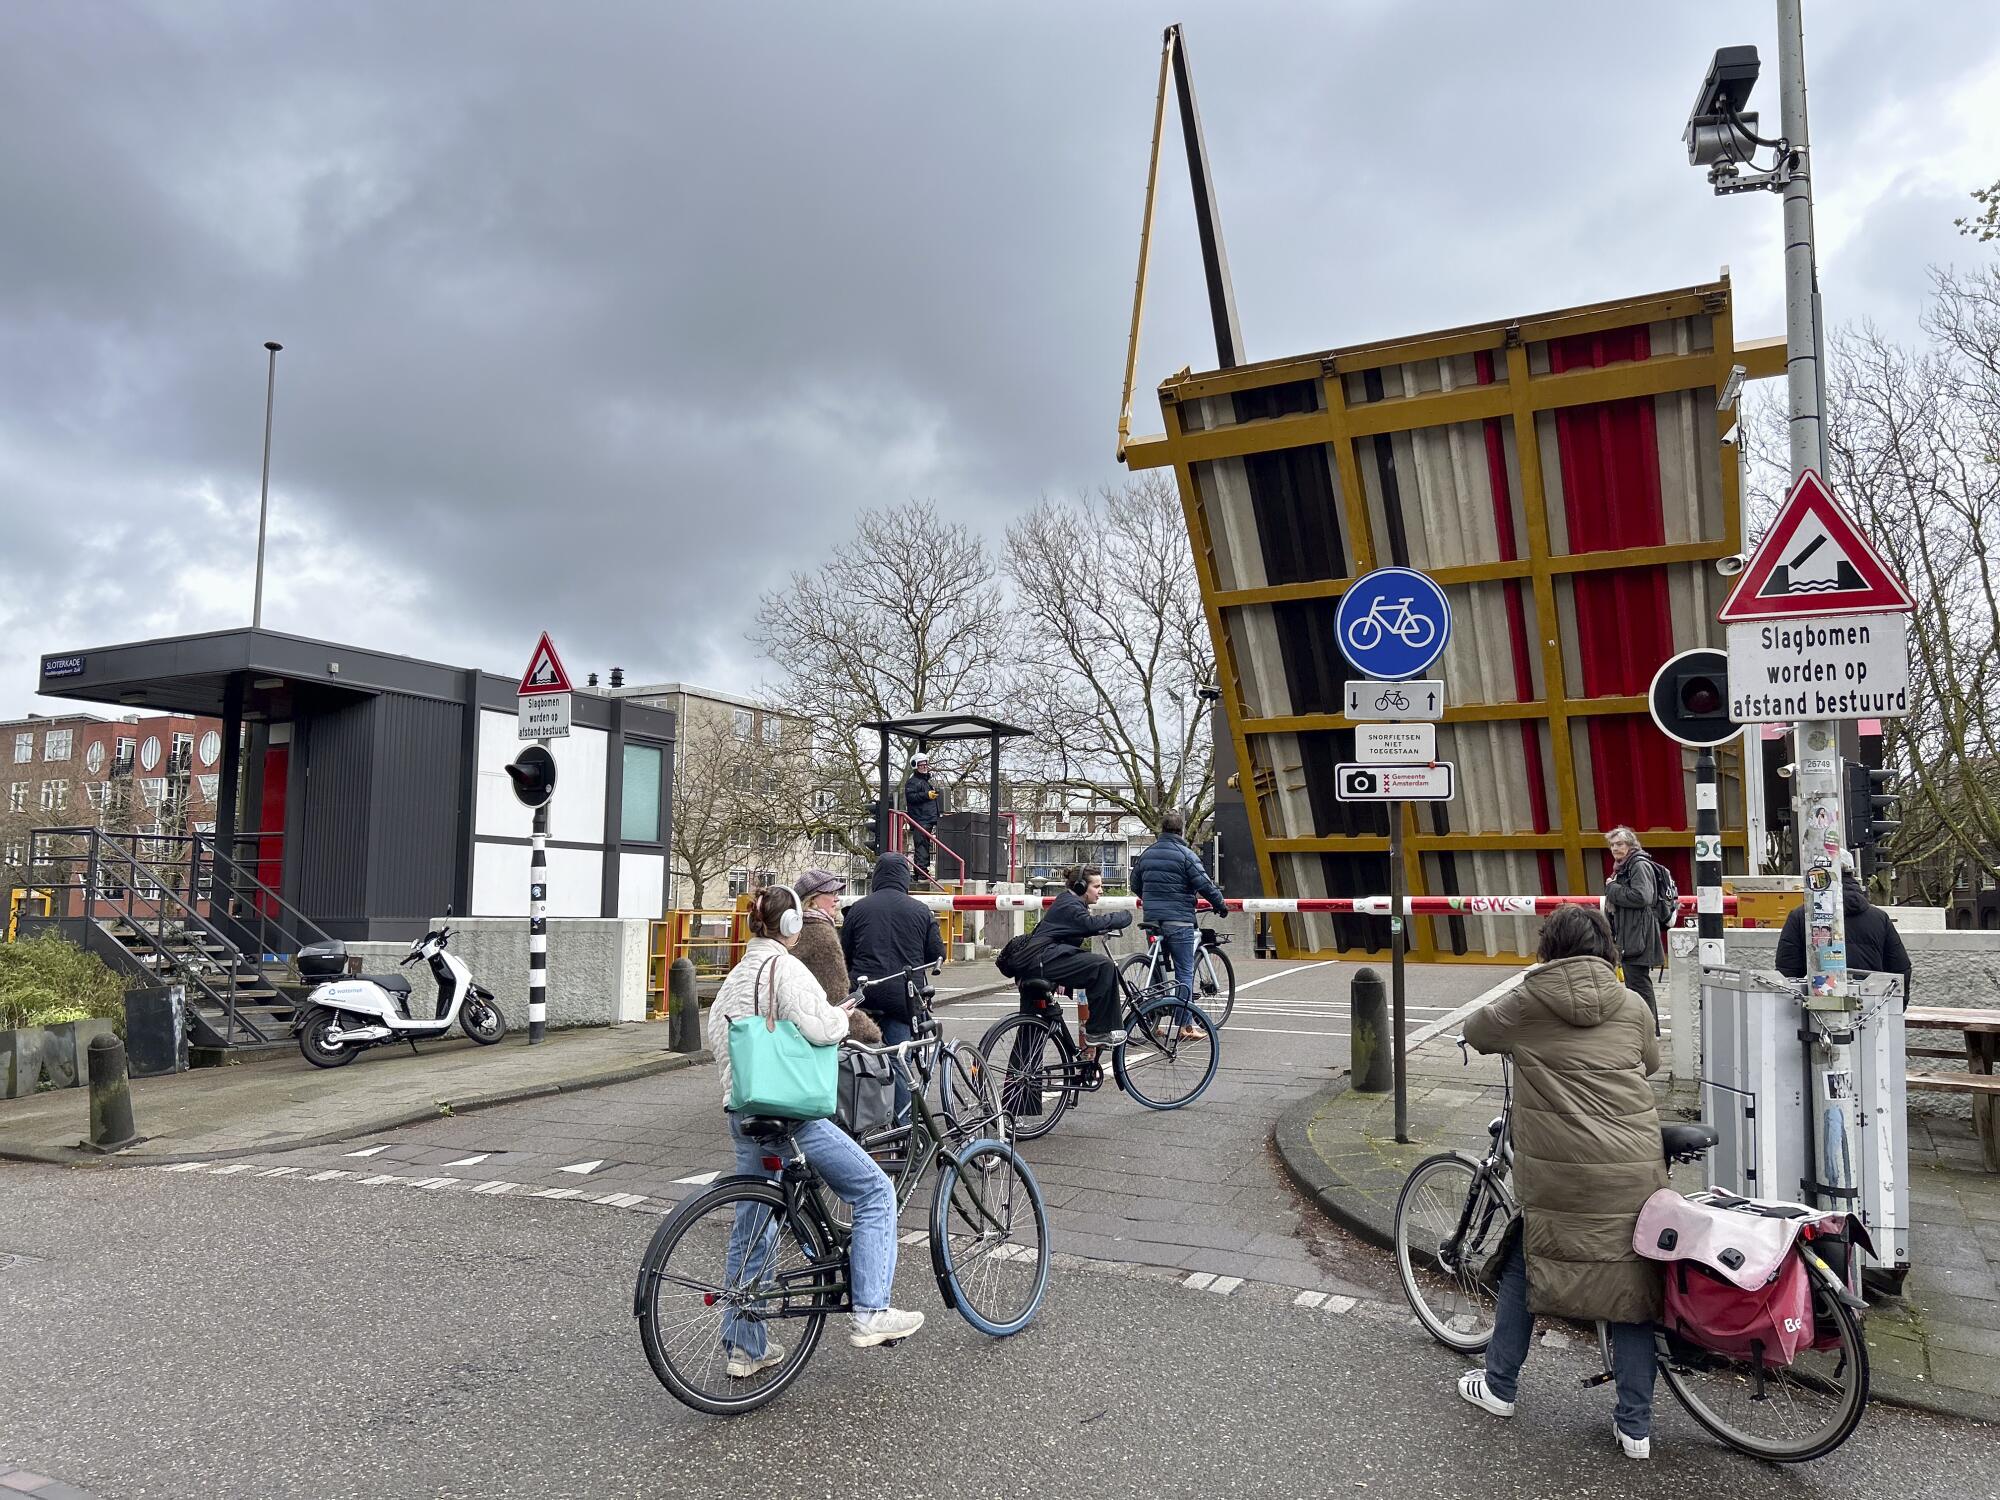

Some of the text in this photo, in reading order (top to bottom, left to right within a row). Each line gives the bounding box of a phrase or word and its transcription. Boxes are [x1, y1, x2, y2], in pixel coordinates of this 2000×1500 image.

[1761, 624, 1870, 655] Slagbomen
[46, 658, 81, 669] SLOTERKADE
[1767, 659, 1867, 684] worden op
[528, 697, 560, 710] Slagbomen
[1733, 686, 1906, 718] afstand bestuurd
[530, 712, 558, 723] worden op
[519, 723, 569, 737] afstand bestuurd
[1807, 760, 1831, 768] 26749
